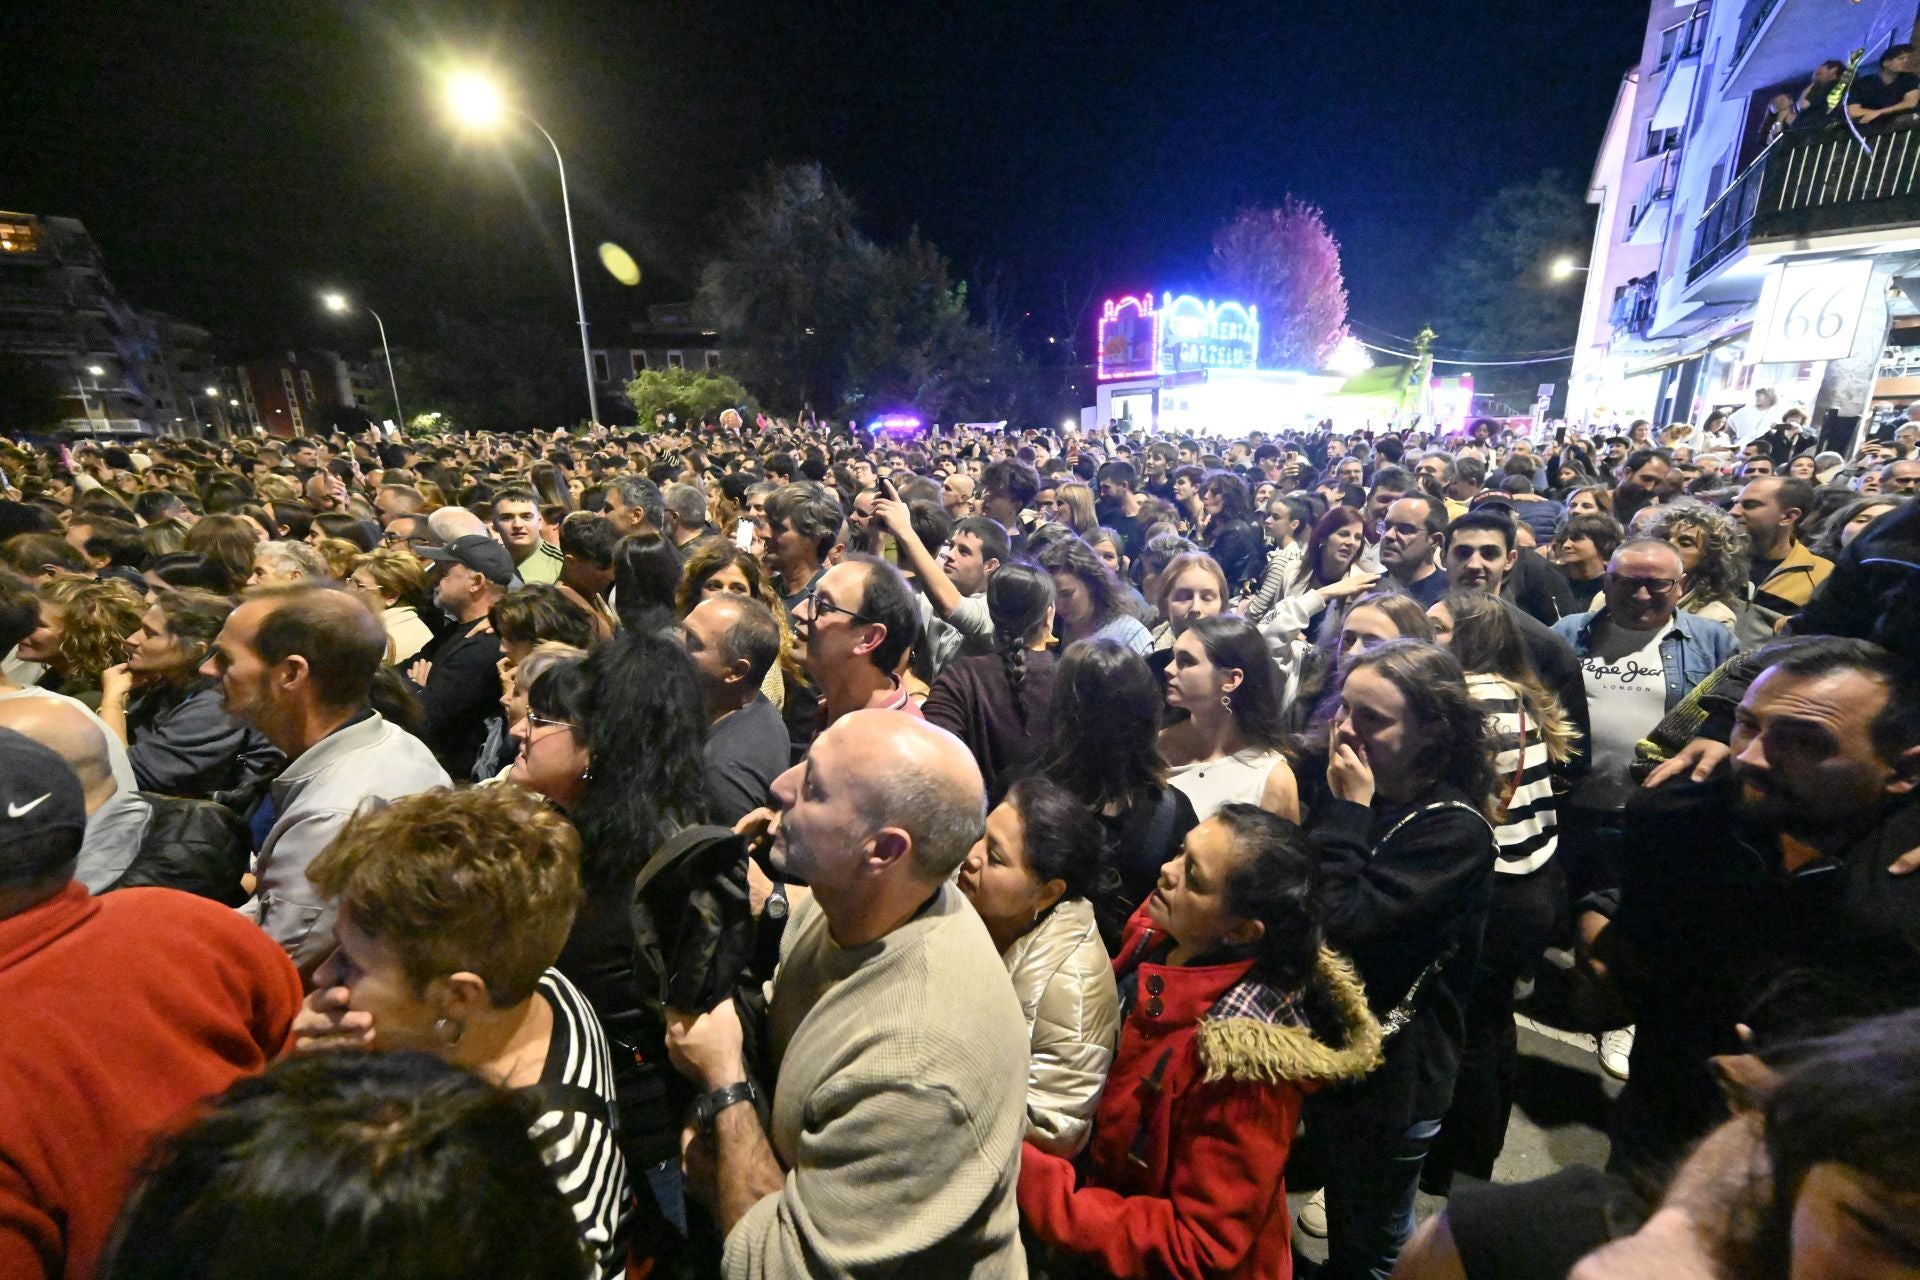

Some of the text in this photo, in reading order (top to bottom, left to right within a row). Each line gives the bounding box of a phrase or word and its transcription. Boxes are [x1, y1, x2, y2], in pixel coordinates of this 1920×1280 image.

[1784, 284, 1848, 340] 66
[1582, 657, 1621, 679] Pepe
[1603, 684, 1651, 692] LONDON
